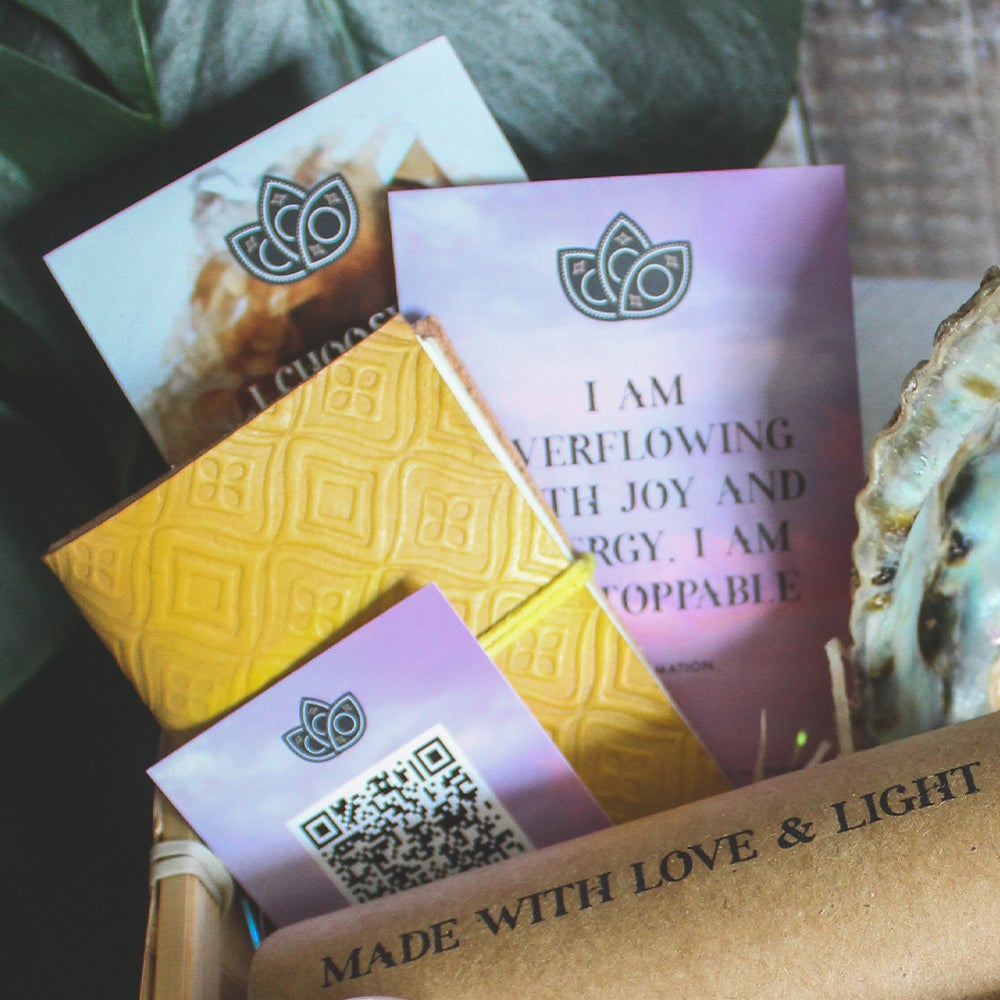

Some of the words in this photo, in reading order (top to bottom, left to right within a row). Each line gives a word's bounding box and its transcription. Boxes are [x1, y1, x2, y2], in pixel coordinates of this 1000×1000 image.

[584, 380, 597, 412] I
[618, 374, 685, 410] AM
[511, 416, 795, 468] VERFLOWING
[540, 484, 600, 518] TH
[620, 476, 695, 514] JOY
[717, 468, 807, 506] AND
[692, 526, 706, 558] I
[726, 520, 791, 556] AM
[320, 918, 461, 988] MADE
[475, 871, 616, 936] WITH
[629, 829, 759, 894] LOVE
[777, 816, 817, 850] &
[830, 761, 983, 834] LIGHT
